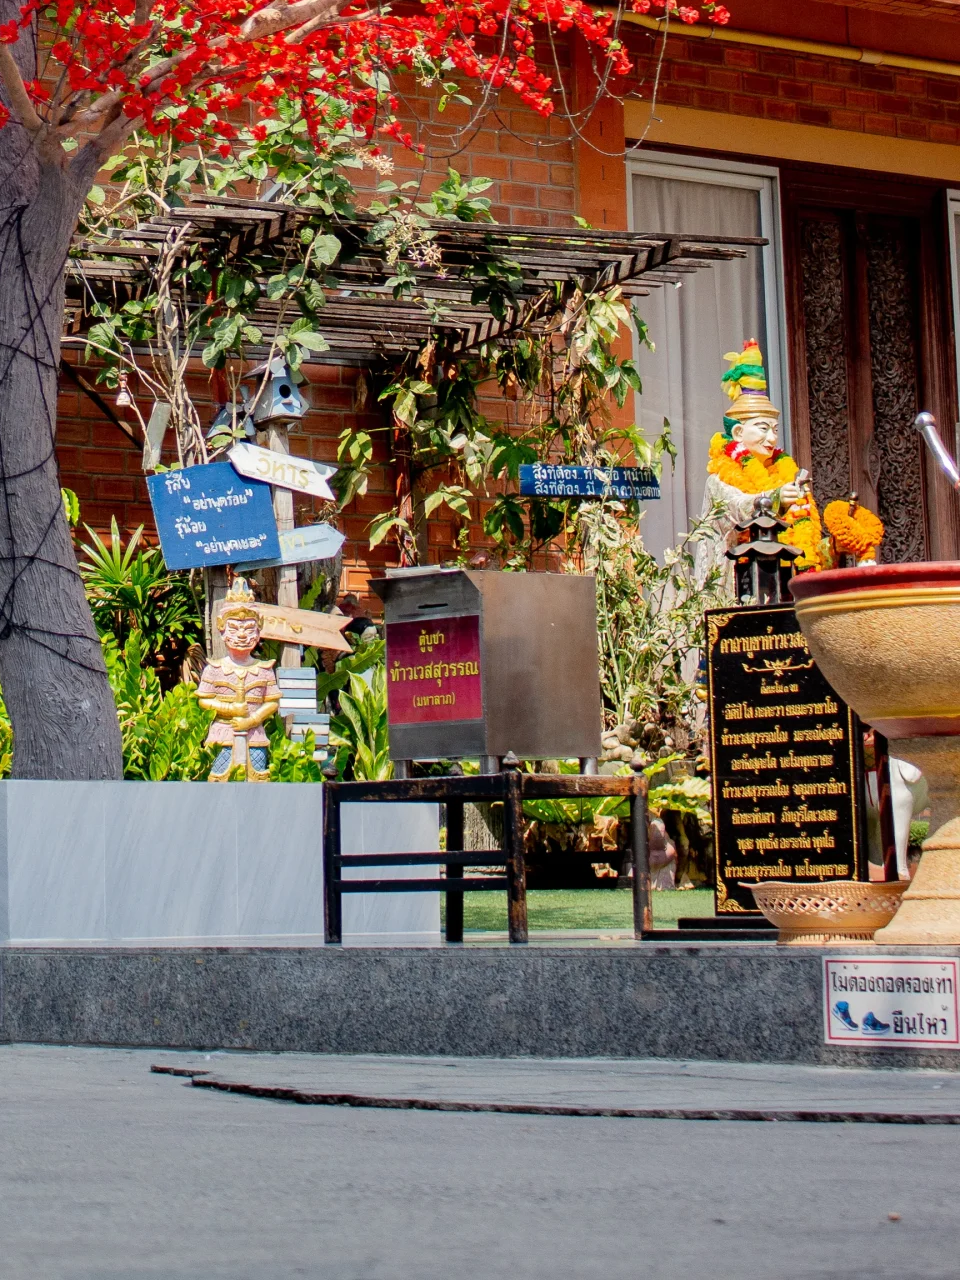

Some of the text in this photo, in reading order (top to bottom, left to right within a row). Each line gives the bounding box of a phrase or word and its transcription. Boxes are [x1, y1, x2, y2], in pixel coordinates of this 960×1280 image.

[418, 629, 445, 653] ตู้บูชา
[390, 661, 479, 687] ท้าวเวสสุวรรณ
[412, 693, 456, 708] (มหาลาภ)
[831, 964, 953, 994] ไม่ต้องถอดรองเท้า
[892, 1004, 948, 1035] ยืนไหว้
